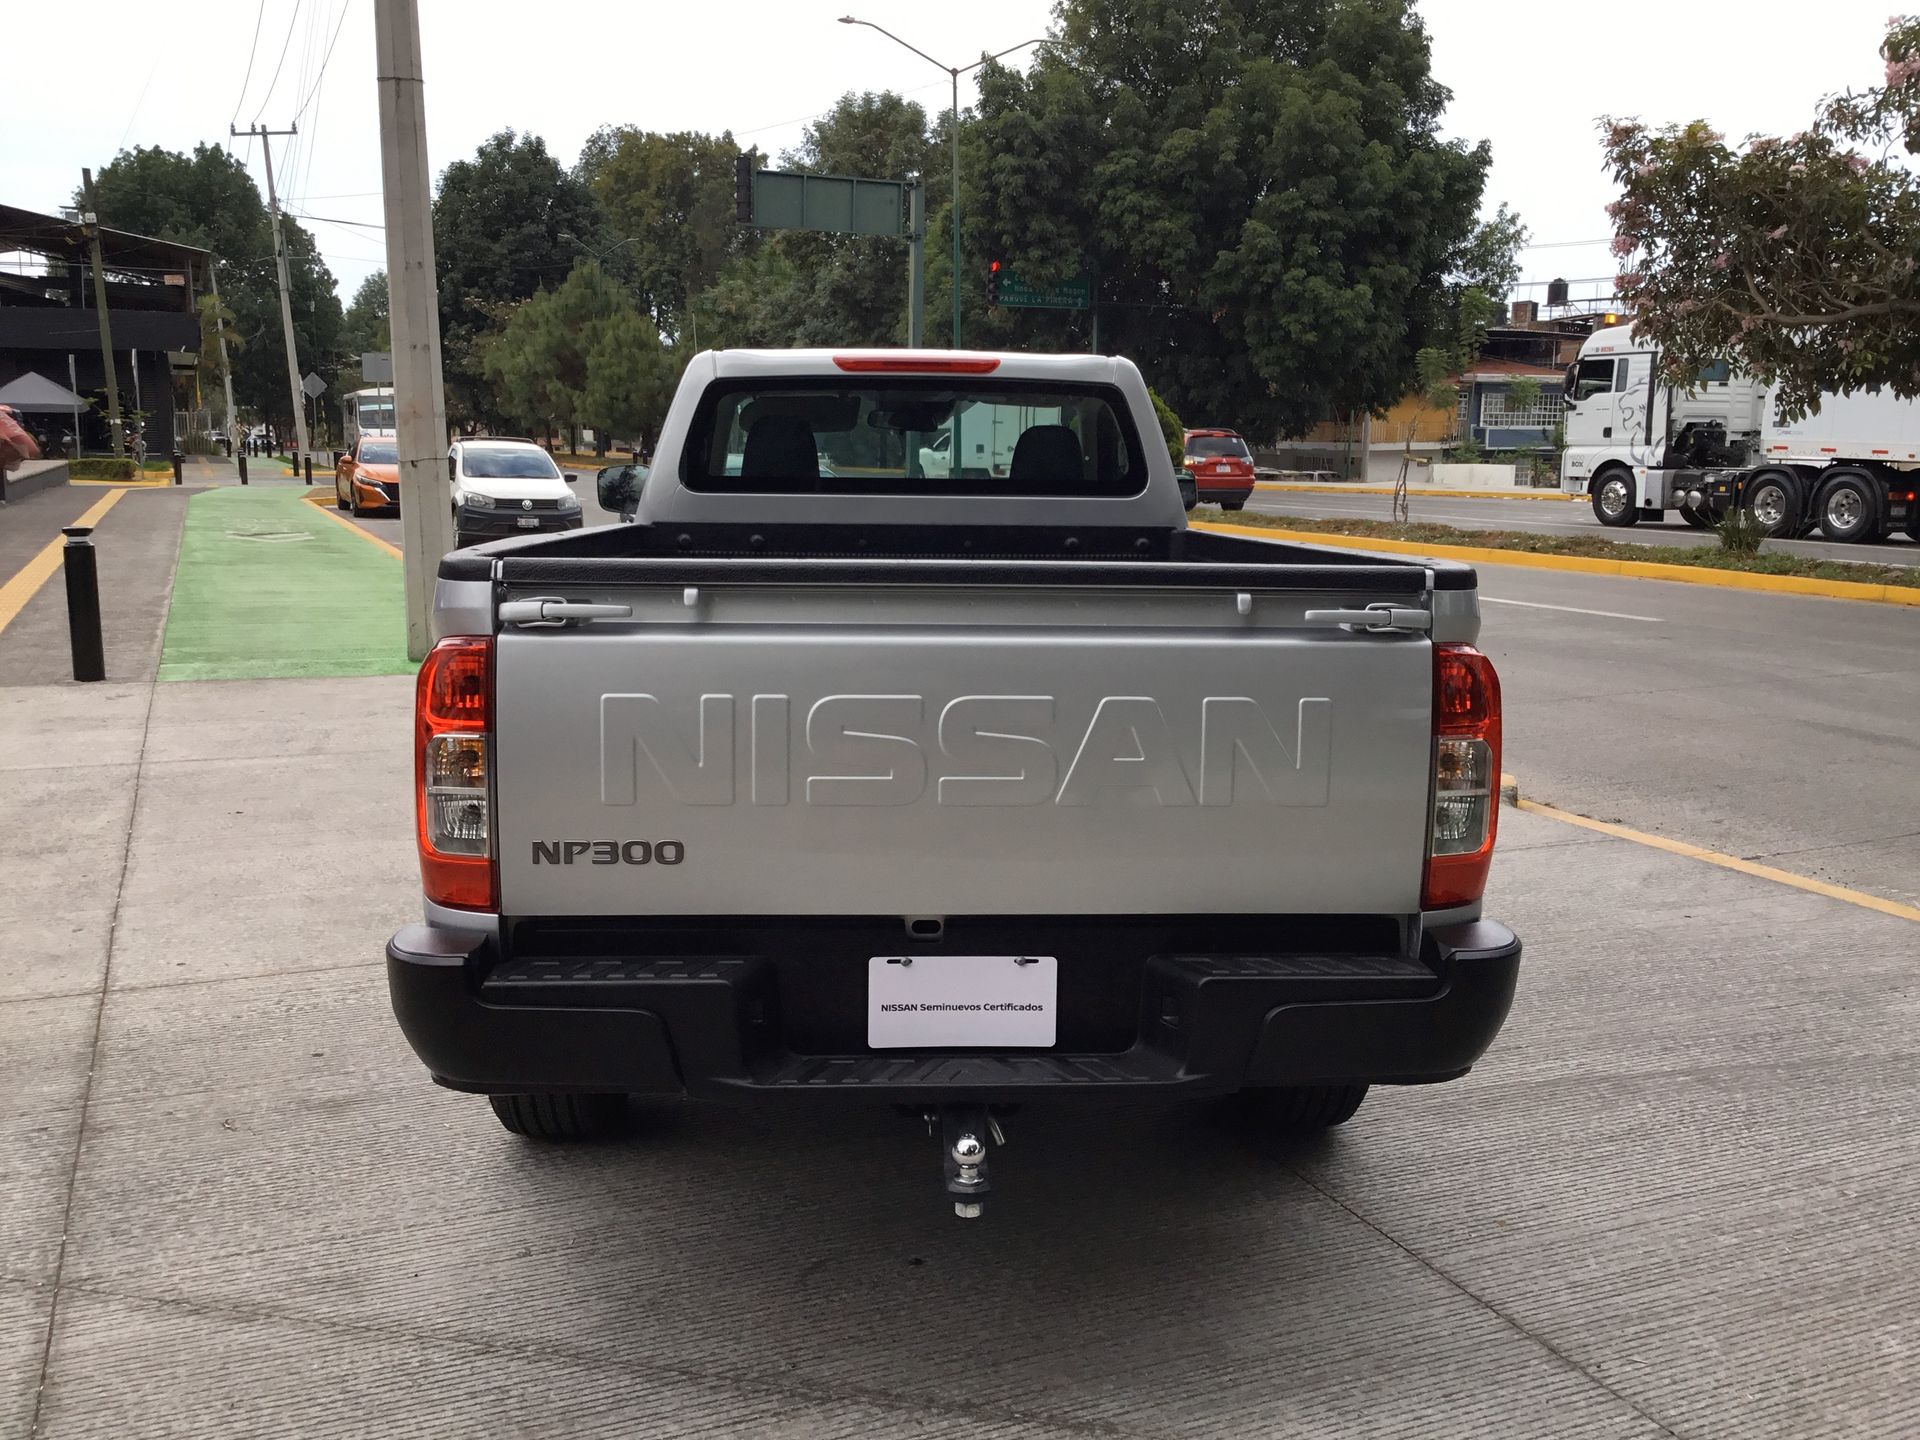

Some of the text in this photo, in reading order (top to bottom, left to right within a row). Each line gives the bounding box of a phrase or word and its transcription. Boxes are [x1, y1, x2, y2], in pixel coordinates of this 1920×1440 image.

[999, 295, 1028, 303] PARQUE
[1031, 296, 1042, 304] LA
[599, 692, 1333, 808] NISSAN
[531, 839, 685, 867] NP300
[881, 1002, 1043, 1012] NISSAN Seminuevos Certificados
